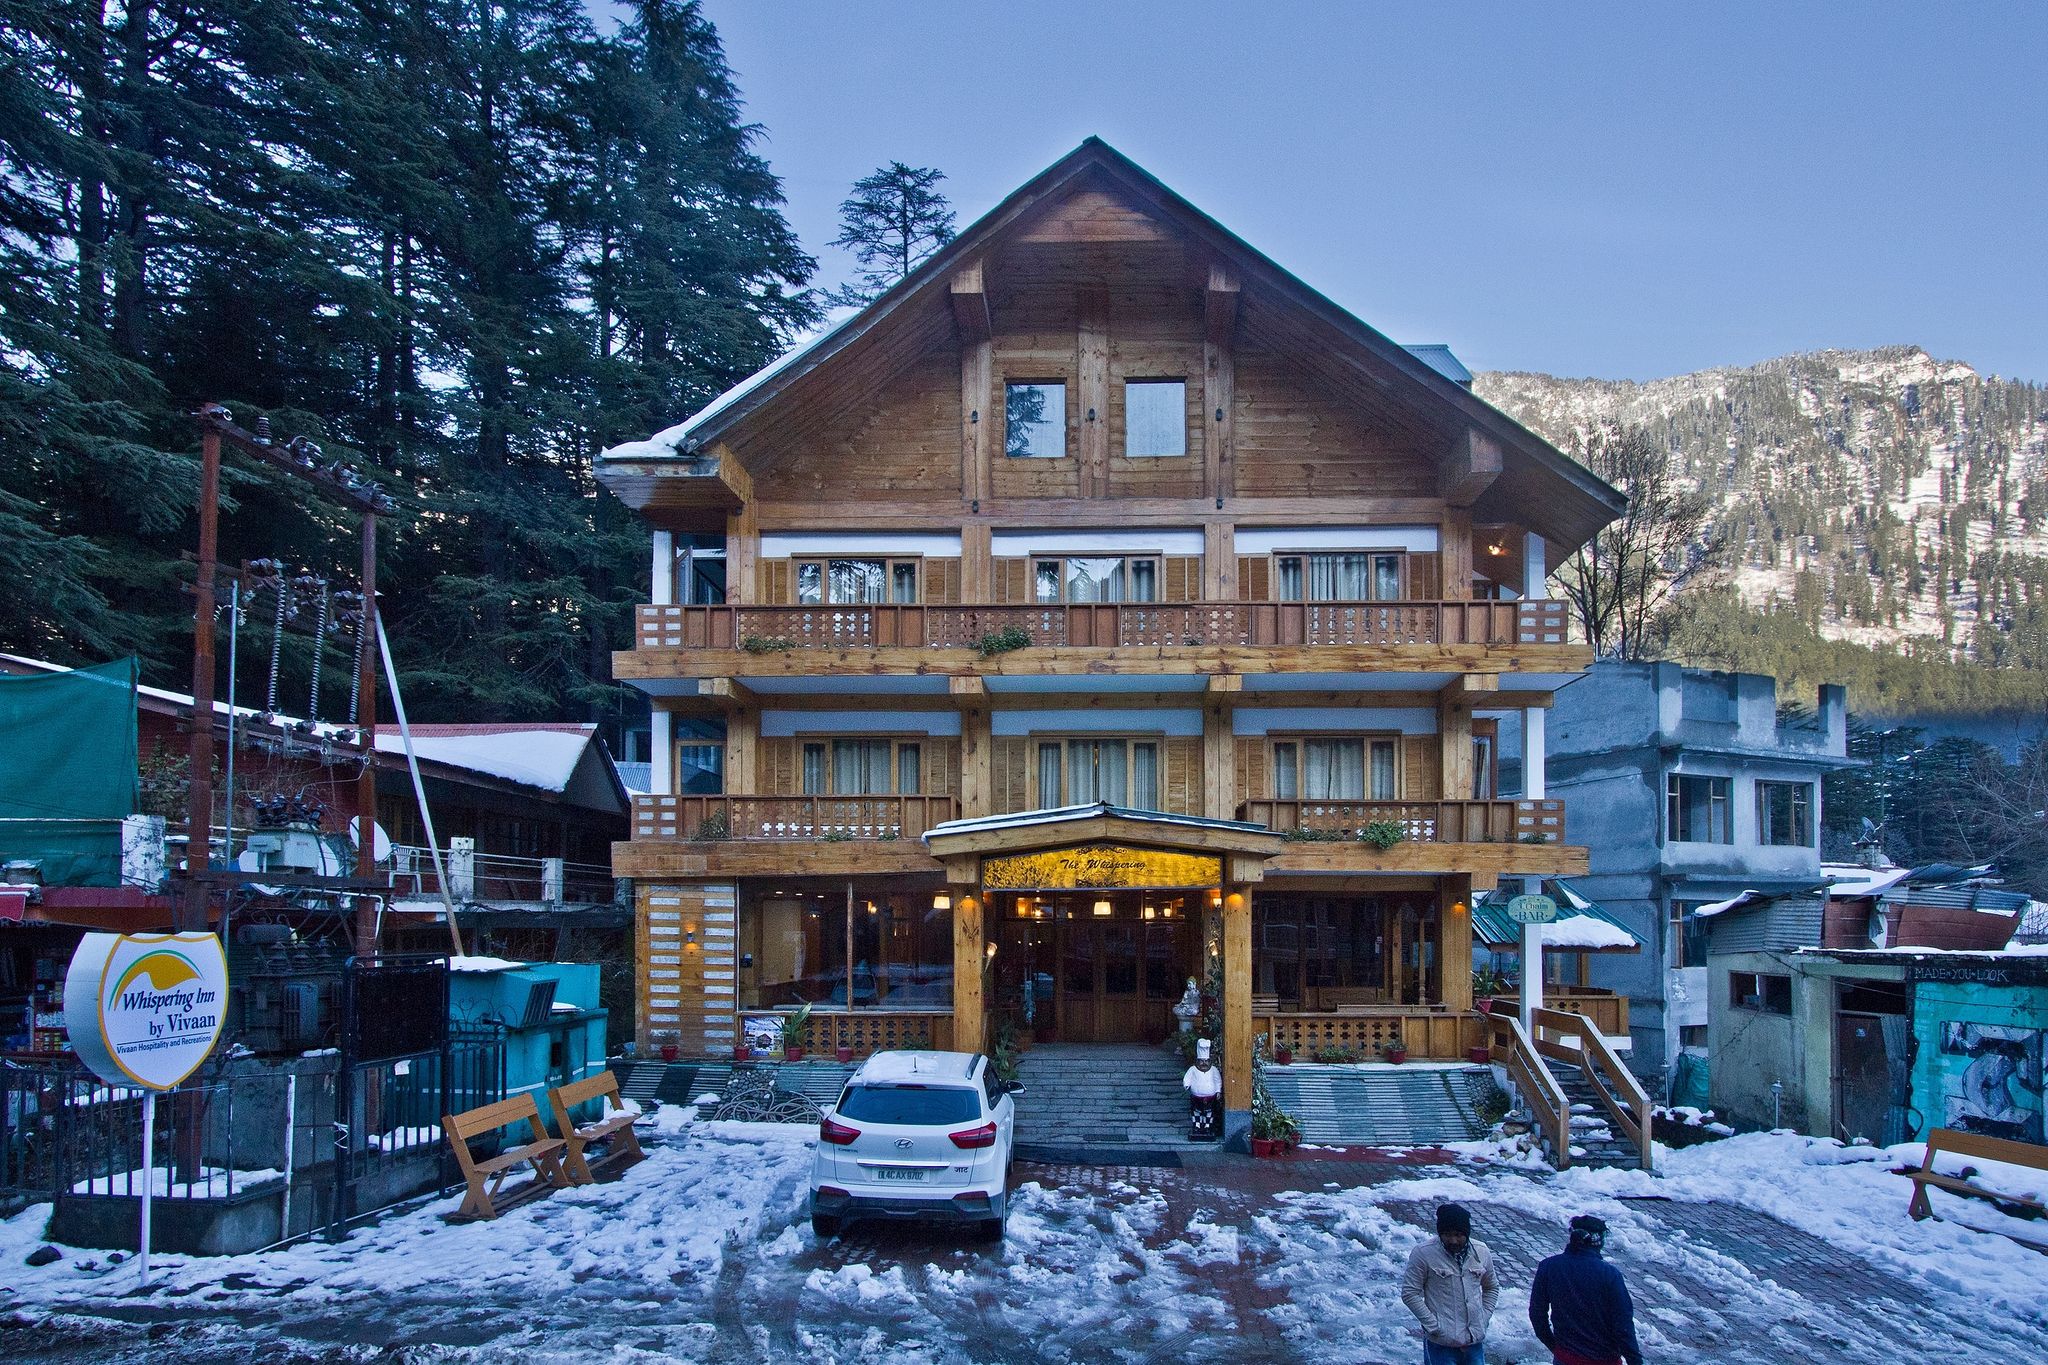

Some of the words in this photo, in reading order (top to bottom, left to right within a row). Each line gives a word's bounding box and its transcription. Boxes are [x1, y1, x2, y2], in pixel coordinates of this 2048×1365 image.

[1060, 859, 1079, 870] The
[1083, 859, 1147, 875] Whispering
[1519, 911, 1545, 921] BAR
[123, 989, 195, 1014] Whispering
[196, 987, 216, 1004] Inn
[149, 1021, 164, 1038] by
[167, 1014, 216, 1032] Vivaan
[116, 1045, 137, 1055] Vivaan
[138, 1041, 169, 1052] Hospitality
[170, 1039, 181, 1047] and
[181, 1034, 212, 1045] Recreations
